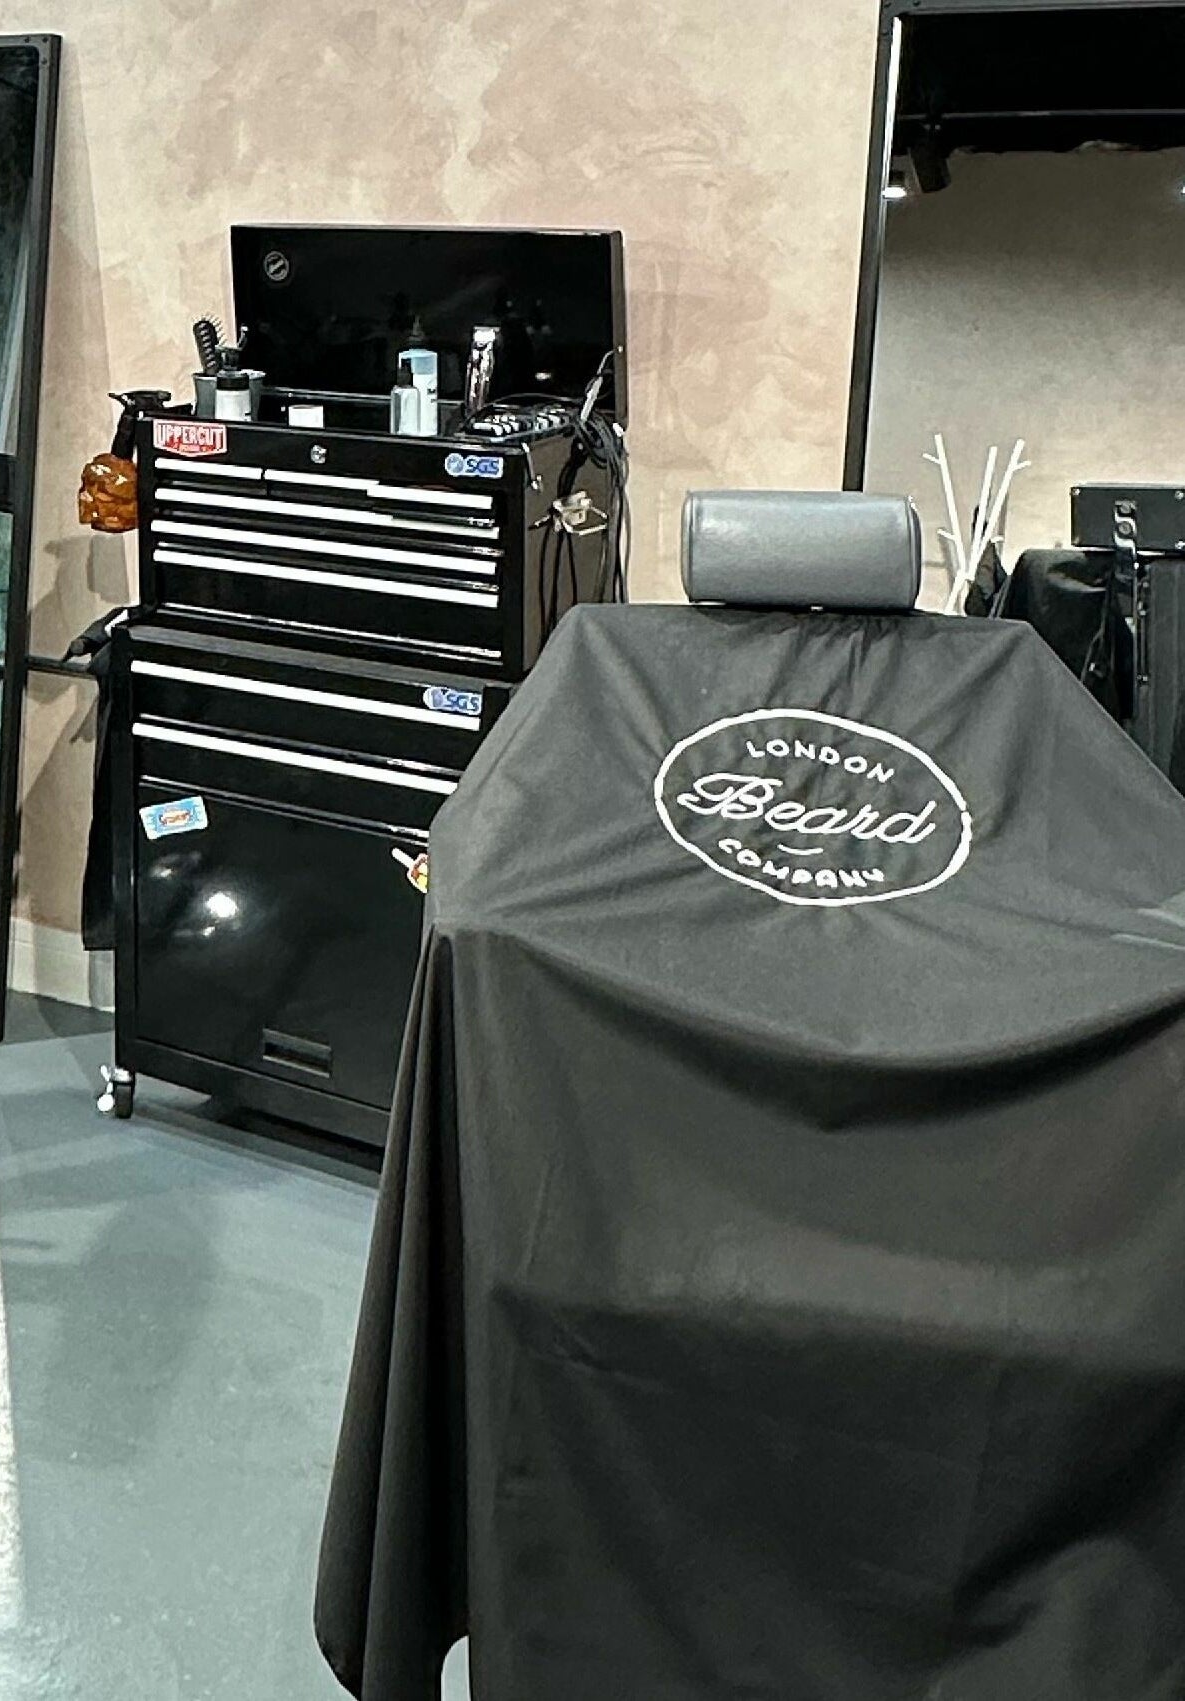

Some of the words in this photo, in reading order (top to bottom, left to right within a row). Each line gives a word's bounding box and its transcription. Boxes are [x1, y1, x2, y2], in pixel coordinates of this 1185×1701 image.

[156, 423, 224, 450] UPPERCUT
[465, 458, 500, 476] SGS
[444, 692, 480, 712] SGS
[745, 738, 895, 784] LONDON
[676, 772, 937, 844] Beard
[718, 837, 885, 889] COMPANY
